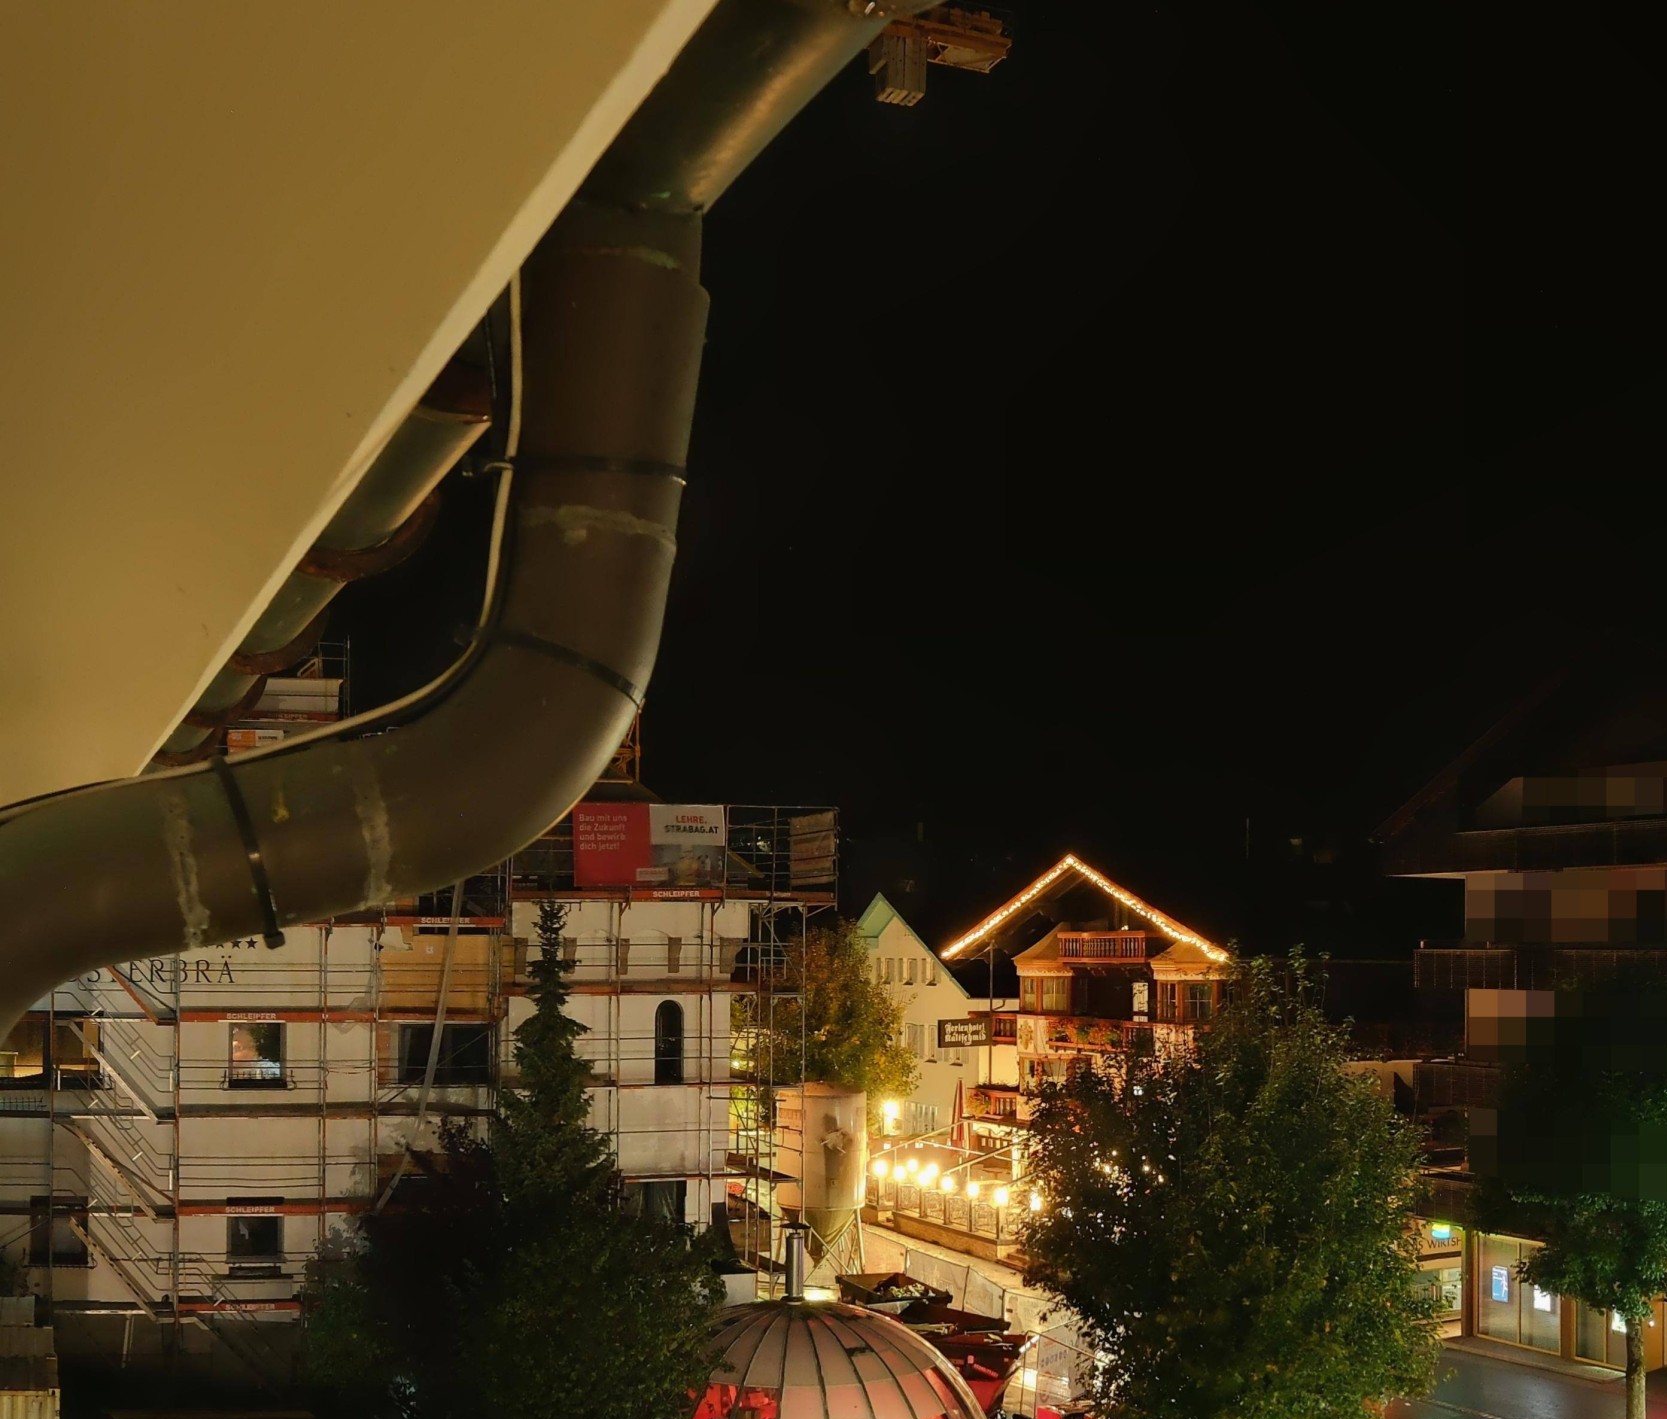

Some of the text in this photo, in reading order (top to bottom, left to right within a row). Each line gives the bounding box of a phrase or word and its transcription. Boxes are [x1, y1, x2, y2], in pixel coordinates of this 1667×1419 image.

[597, 814, 610, 822] mit
[664, 825, 720, 834] STRABAG.AT
[652, 890, 700, 898] SCHLEIPFER
